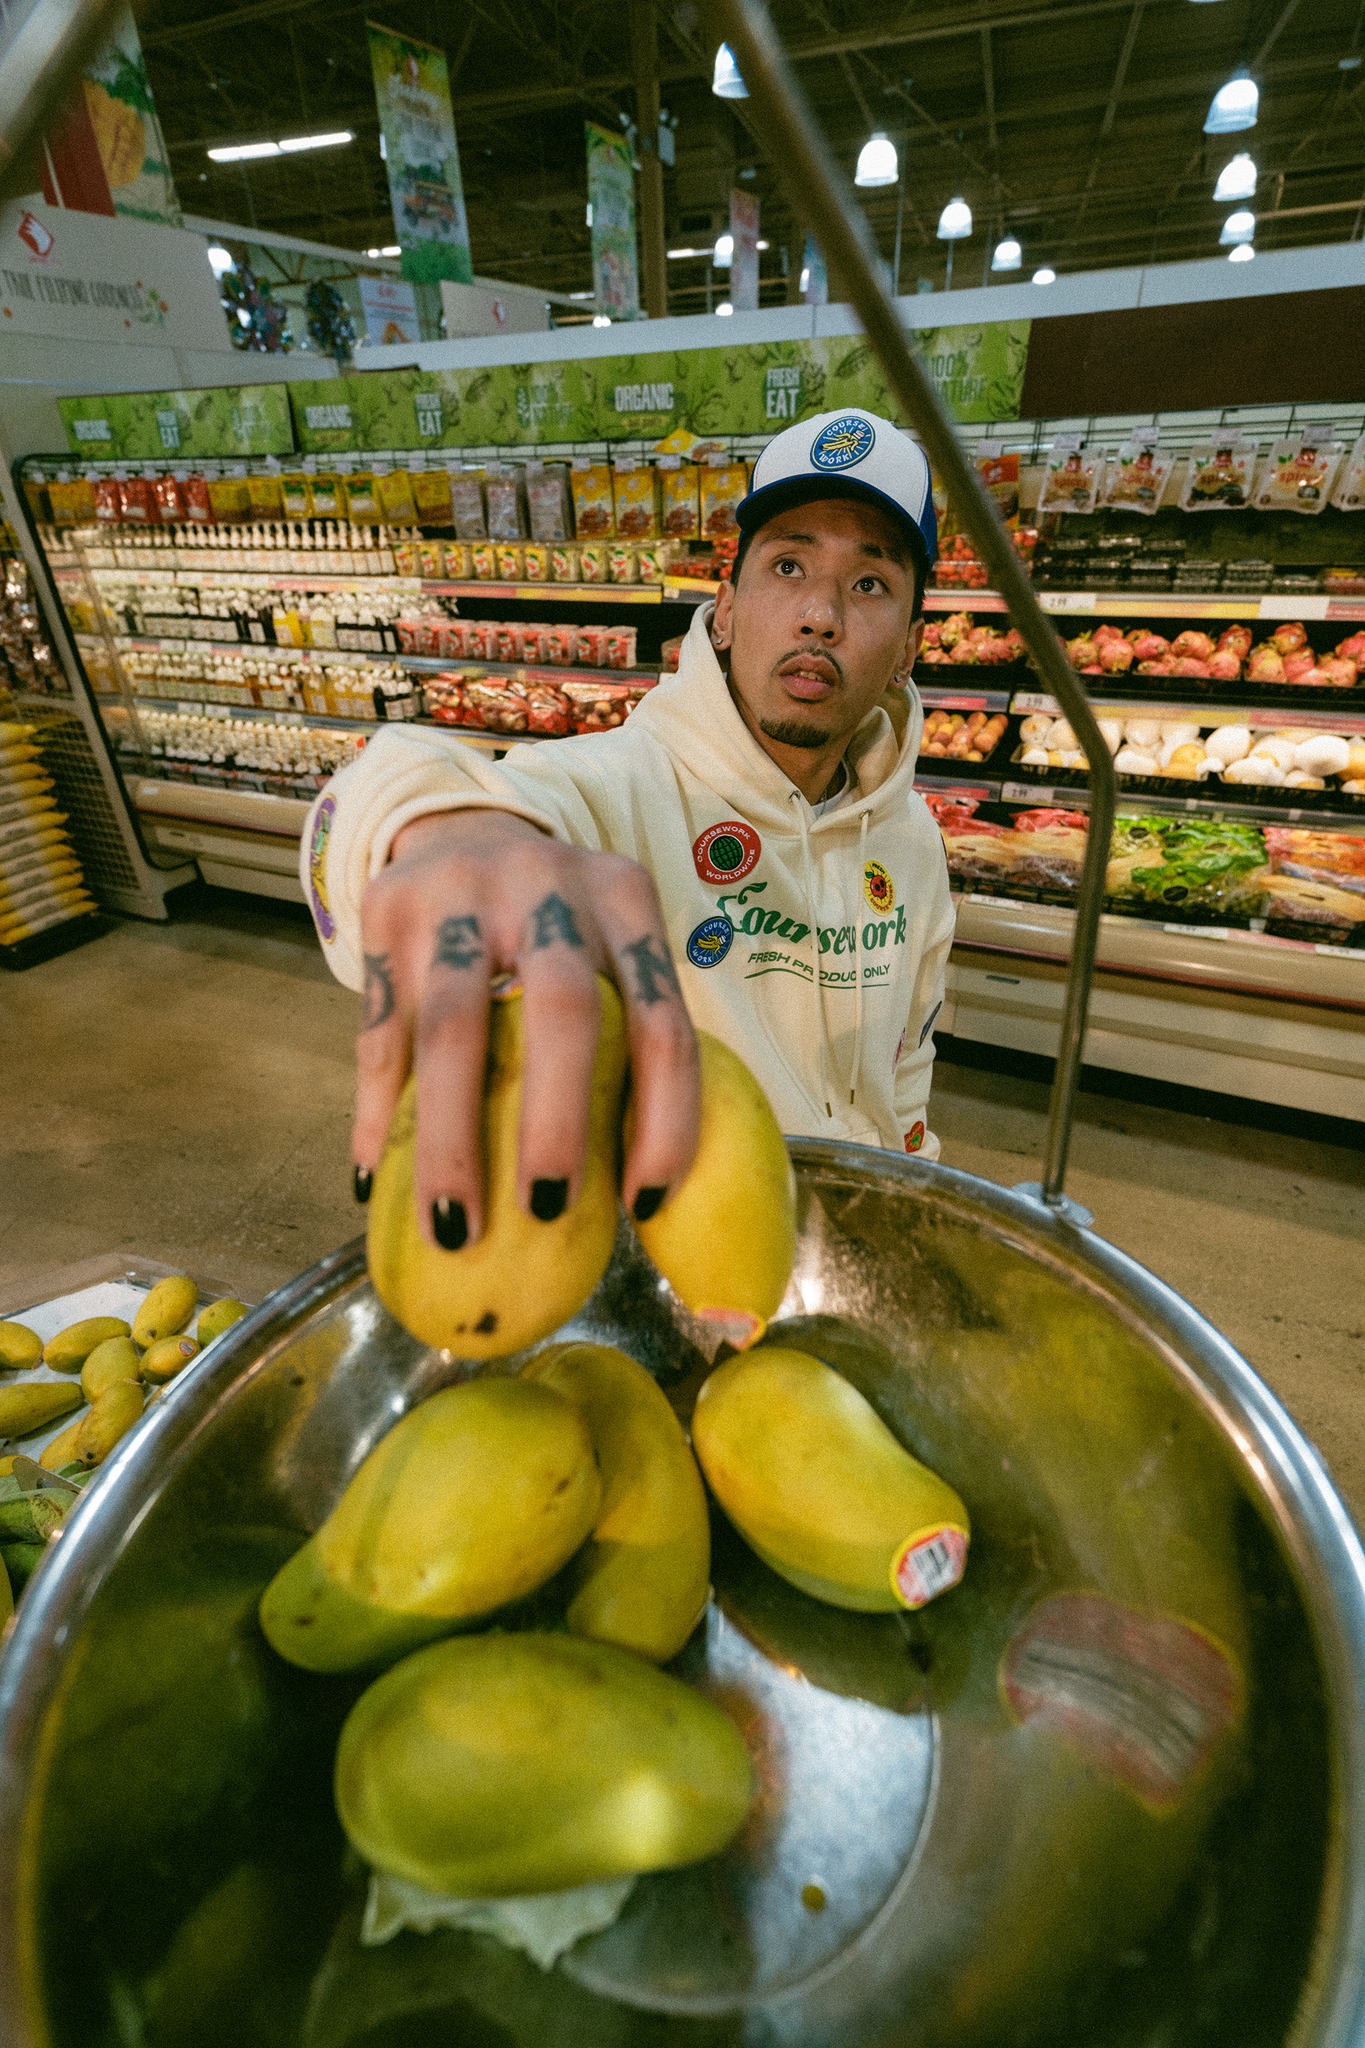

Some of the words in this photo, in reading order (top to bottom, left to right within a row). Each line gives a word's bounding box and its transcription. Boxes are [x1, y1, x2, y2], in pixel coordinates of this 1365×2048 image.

[766, 367, 801, 388] FRESH
[614, 383, 675, 412] ORGANIC
[766, 388, 800, 418] EAT
[417, 411, 443, 436] EAT
[827, 420, 866, 436] COURSE
[819, 453, 850, 465] WORK
[696, 825, 751, 863] COURSEWORK
[705, 848, 756, 881] WORLDWIDE
[703, 921, 730, 934] COURSE
[691, 949, 713, 964] WORK
[748, 951, 791, 965] FRESH
[863, 964, 891, 979] ONLY
